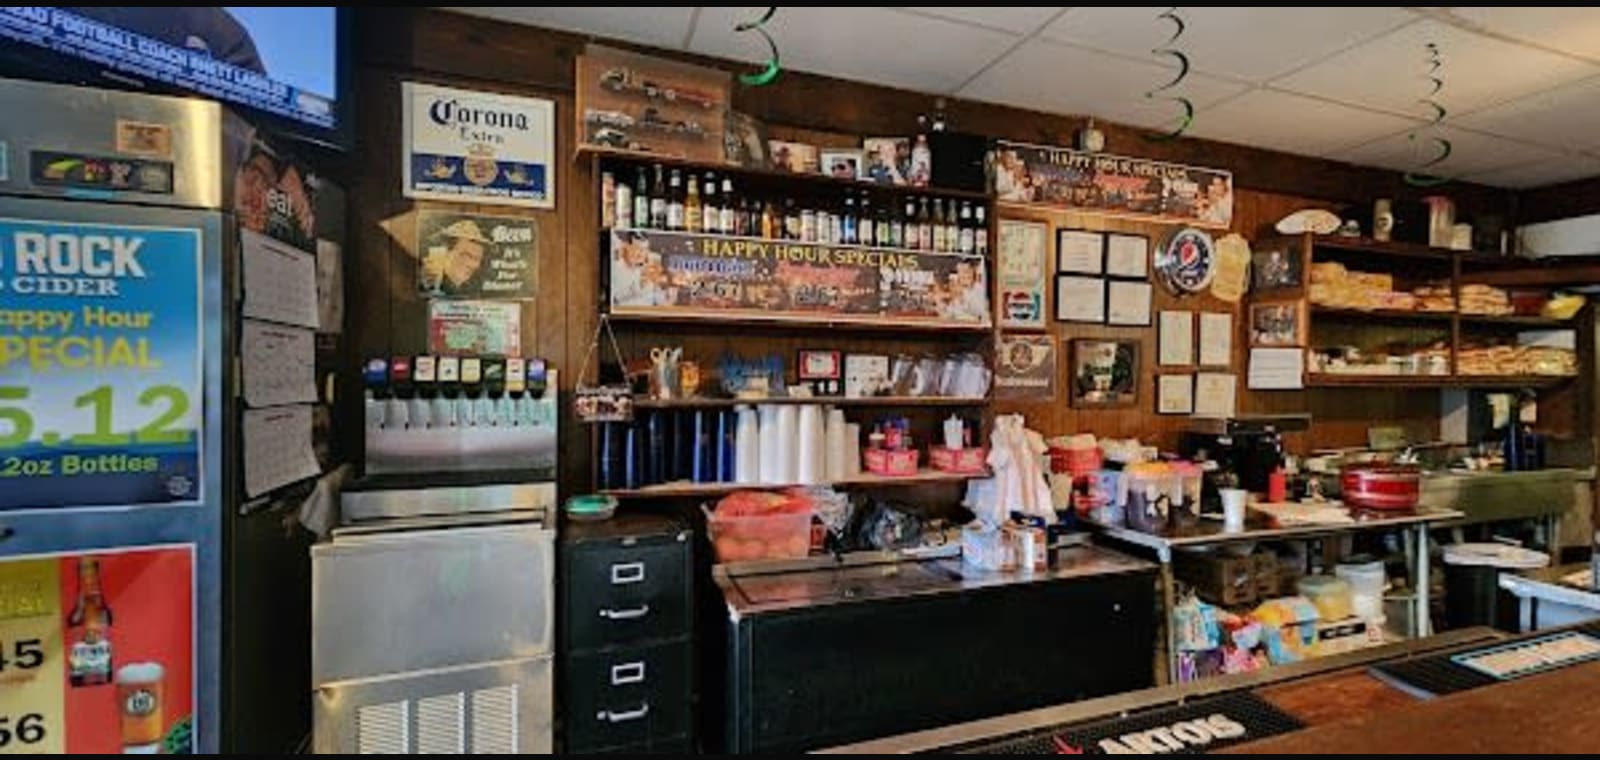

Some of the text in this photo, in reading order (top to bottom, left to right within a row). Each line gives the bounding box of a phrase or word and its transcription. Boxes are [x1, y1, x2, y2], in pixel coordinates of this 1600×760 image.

[51, 9, 137, 50] FOOTBALL
[138, 36, 188, 66] COACH
[429, 98, 529, 131] Corona
[460, 126, 505, 143] Extra
[14, 231, 147, 278] ROCK
[702, 238, 919, 270] HAPPY HOUR SPECIALS
[11, 275, 120, 296] CIDER
[82, 305, 154, 328] Hour
[60, 454, 159, 476] Bottles
